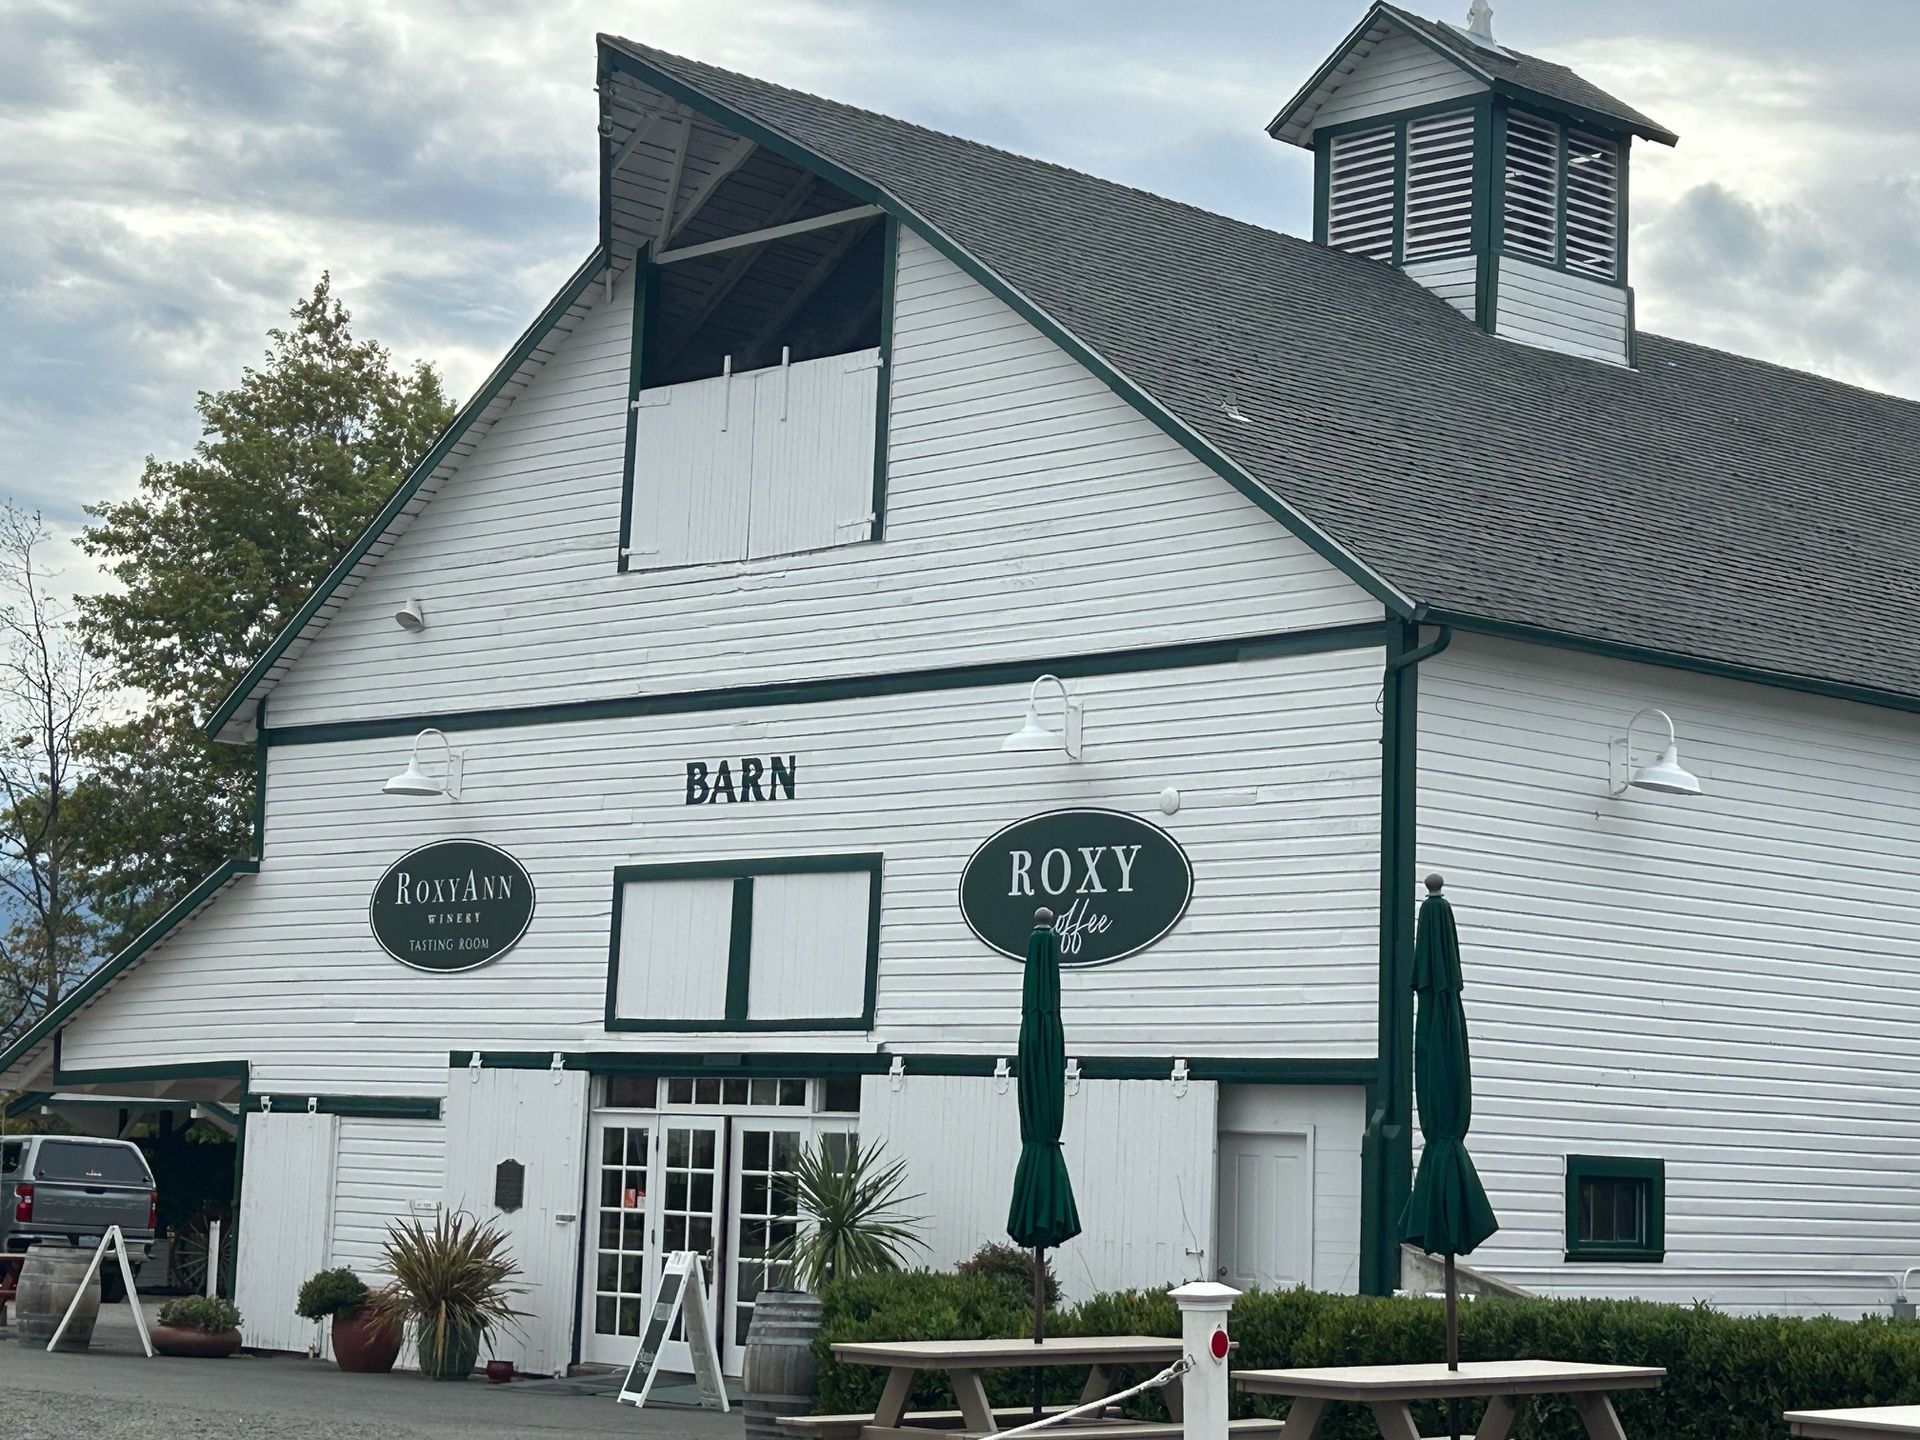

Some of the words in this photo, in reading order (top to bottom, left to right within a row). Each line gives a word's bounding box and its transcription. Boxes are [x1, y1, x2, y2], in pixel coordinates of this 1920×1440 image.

[685, 755, 796, 805] BARN
[1008, 845, 1142, 896] ROXY
[427, 912, 481, 925] WINERY
[1050, 898, 1113, 954] offee
[409, 939, 454, 952] TASTING
[458, 937, 490, 951] ROOM
